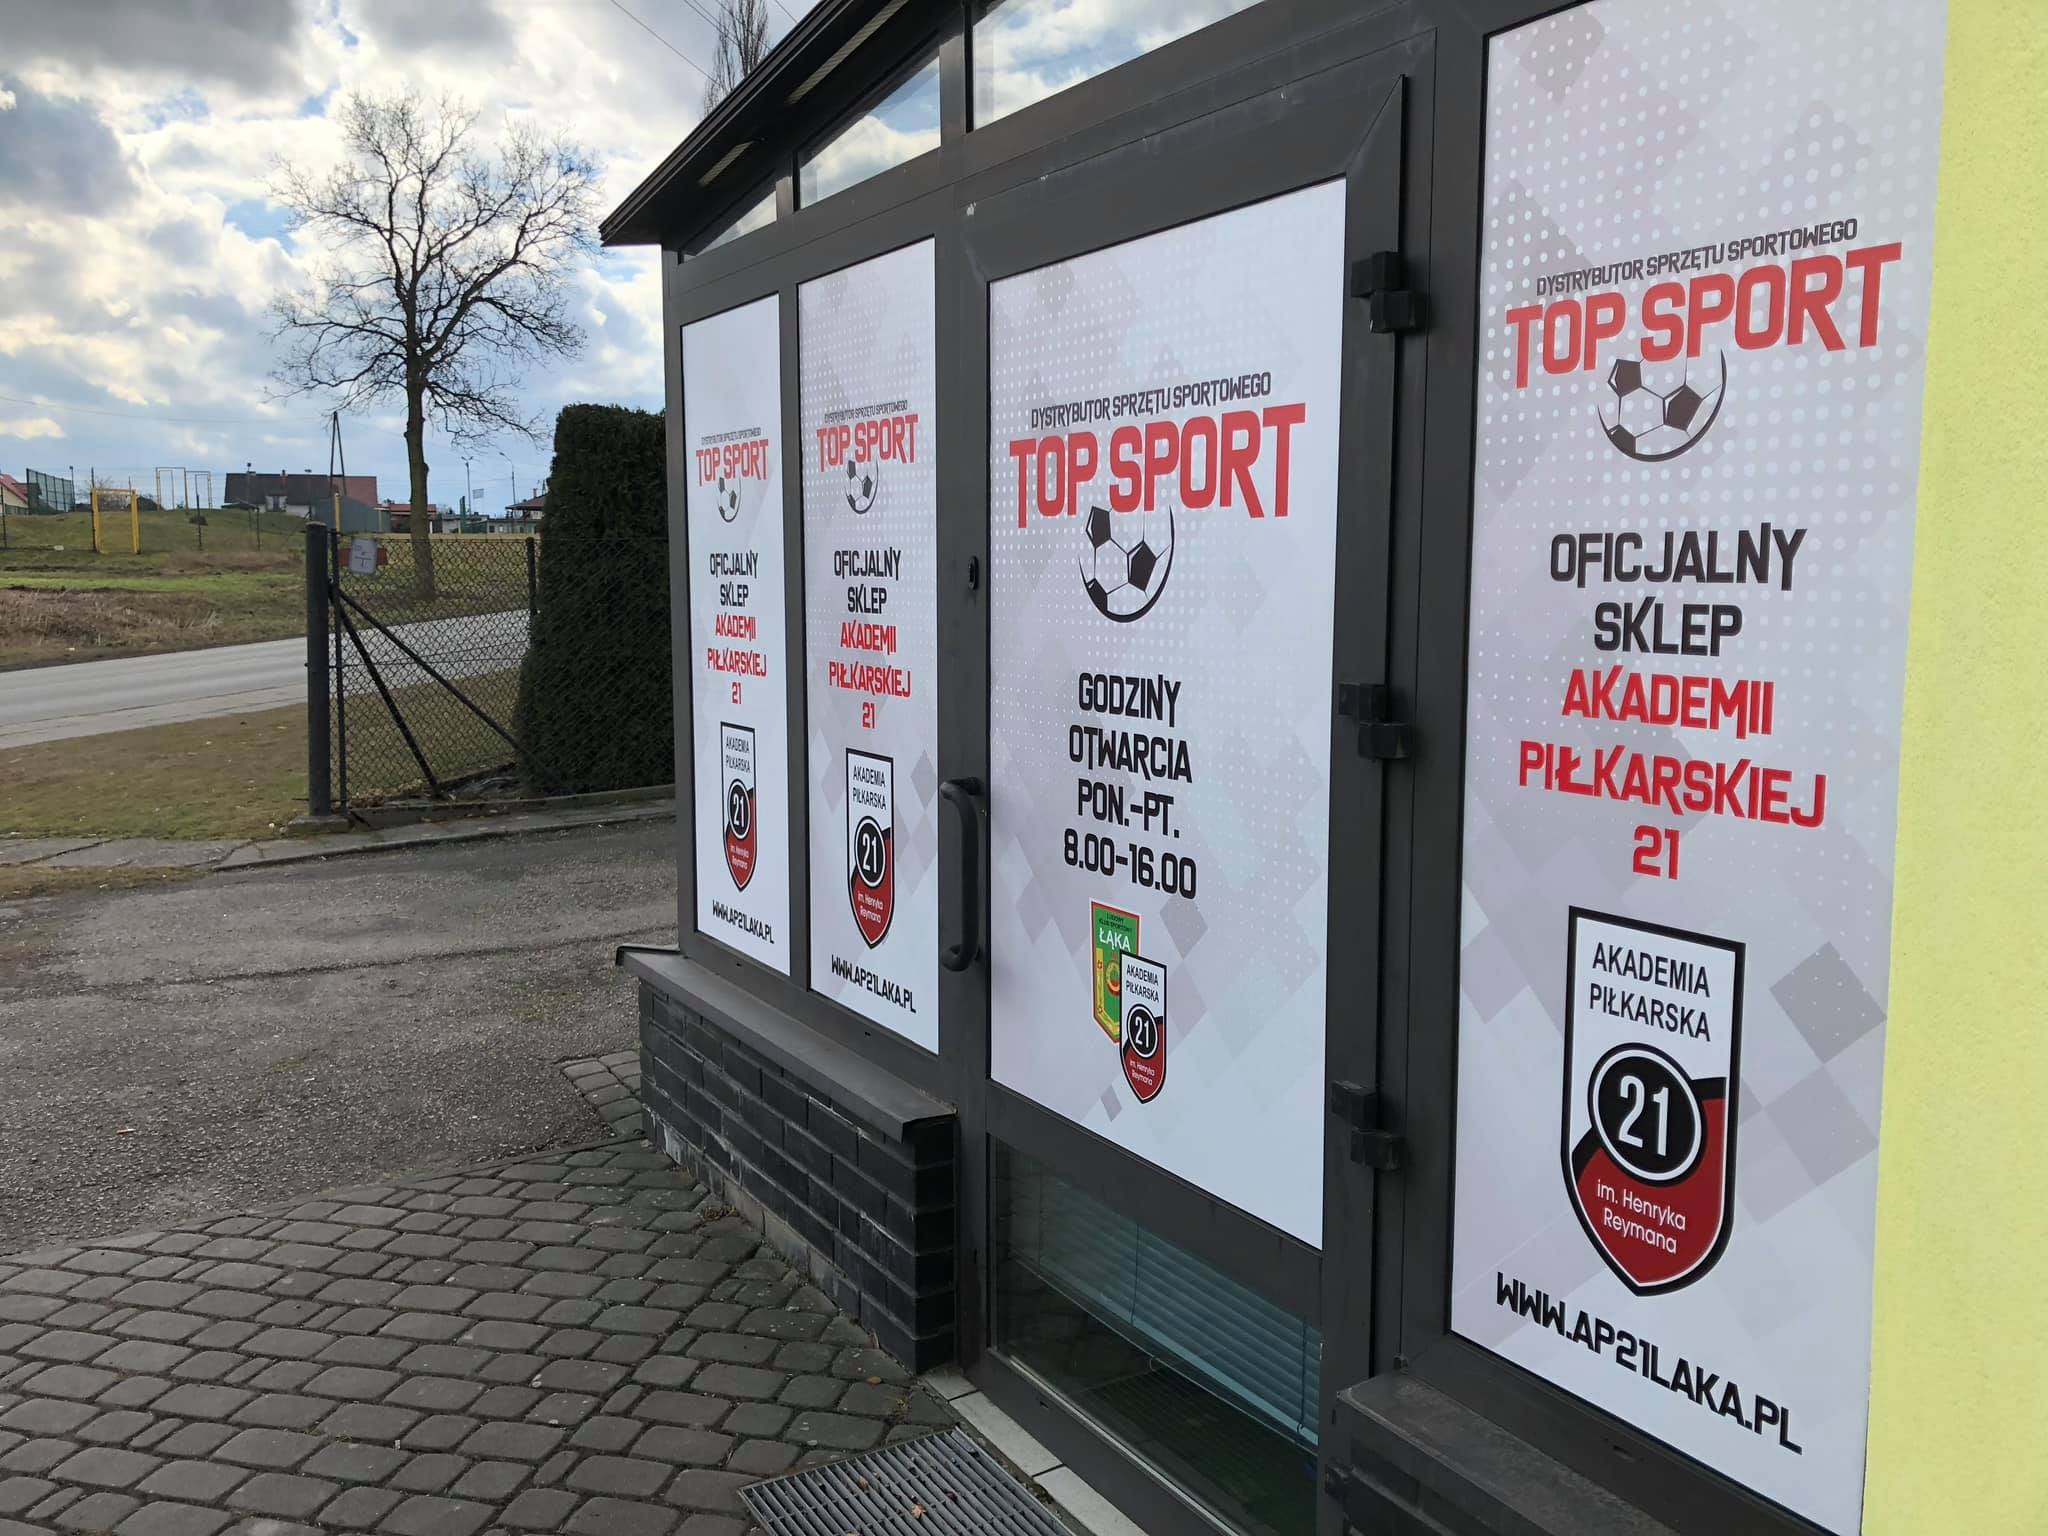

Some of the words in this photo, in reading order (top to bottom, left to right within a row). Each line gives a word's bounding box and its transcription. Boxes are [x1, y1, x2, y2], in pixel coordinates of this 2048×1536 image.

[1536, 256, 1644, 296] DYSTRYBUTOR
[1646, 243, 1725, 276] SPRZĘTU
[1727, 218, 1858, 263] SPORTOWEGO
[1505, 291, 1626, 390] TOP
[1640, 242, 1902, 362] SPORT
[1031, 398, 1111, 430] DYSTRYBUTOR
[1112, 387, 1171, 417] SPRZĘTU
[1173, 371, 1272, 408] SPORTOWEGO
[696, 447, 720, 487] TOP
[724, 439, 768, 480] SPORT
[816, 425, 850, 473] TOP
[854, 414, 918, 464] SPORT
[1009, 431, 1098, 529] TOP
[1109, 402, 1306, 519] SPORT
[710, 549, 758, 579] OFICJALNY
[834, 547, 901, 581] OFICJALNY
[1550, 522, 1807, 591] OFICJALNY
[720, 582, 749, 607] SKLEP
[847, 584, 887, 614] SKLEP
[715, 612, 756, 641] AKADEMII
[840, 620, 897, 655] AKADEMII
[1594, 596, 1743, 657] SKLEP
[707, 648, 767, 677] PIŁKARSKIEJ
[829, 661, 911, 698] PIŁKARSKIEJ
[732, 682, 742, 704] 21
[862, 702, 875, 729] 21
[1078, 672, 1181, 727] GODZINY
[1561, 665, 1774, 740] AKADEMII
[853, 765, 886, 787] AKADEMIA
[1069, 724, 1193, 783] OTWARCIA
[733, 793, 745, 827] 21
[1077, 778, 1180, 839] PON.-PT.
[1519, 740, 1827, 828] PIŁKARSKIEJ
[862, 833, 877, 873] 21
[1064, 828, 1197, 900] 8.00-16.00
[1632, 824, 1679, 880] 21
[1099, 927, 1131, 952] ŁĄKA
[831, 954, 917, 1014] WWW.AP21LAKA.PL
[1127, 964, 1158, 986] AKADEMIA
[1591, 941, 1711, 998] AKADEMIA
[1135, 1016, 1149, 1048] 21
[1588, 983, 1712, 1042] PIŁKARSKA
[1617, 1074, 1669, 1157] 21
[1596, 1179, 1619, 1205] im.
[1623, 1188, 1686, 1232] Henryka
[1603, 1207, 1677, 1255] Reymana
[1496, 1271, 1802, 1455] WWW.AP21LAKA.PL
